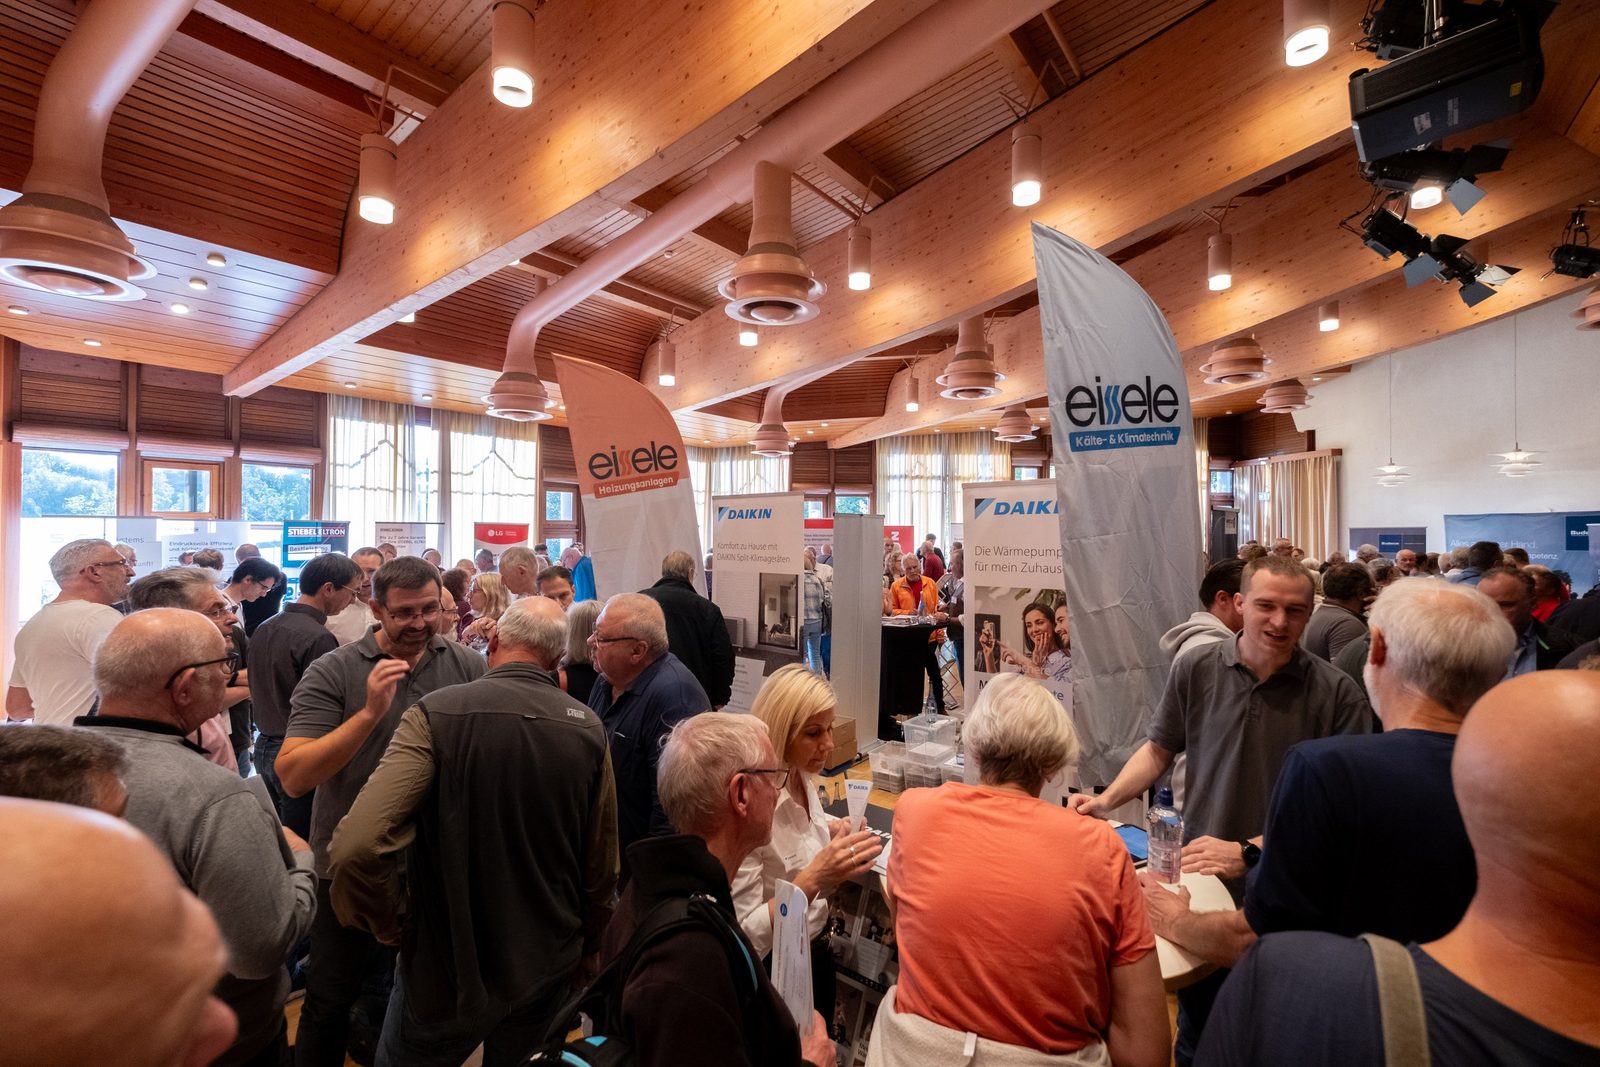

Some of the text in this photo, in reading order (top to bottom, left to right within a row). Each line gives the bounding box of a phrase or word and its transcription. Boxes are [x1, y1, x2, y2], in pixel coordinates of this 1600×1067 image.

[1075, 430, 1174, 447] Kälte- & Klimatechnik
[599, 476, 674, 495] Heizungsanlagen
[728, 508, 772, 520] DAIKIN
[993, 500, 1059, 515] DAIKI
[717, 541, 739, 550] Komfort
[748, 542, 767, 551] Hause
[768, 543, 778, 551] mit
[974, 545, 1063, 560] Die Wärmepump
[717, 552, 736, 561] DAIKIN
[974, 560, 1062, 574] für mein Zuhaus
